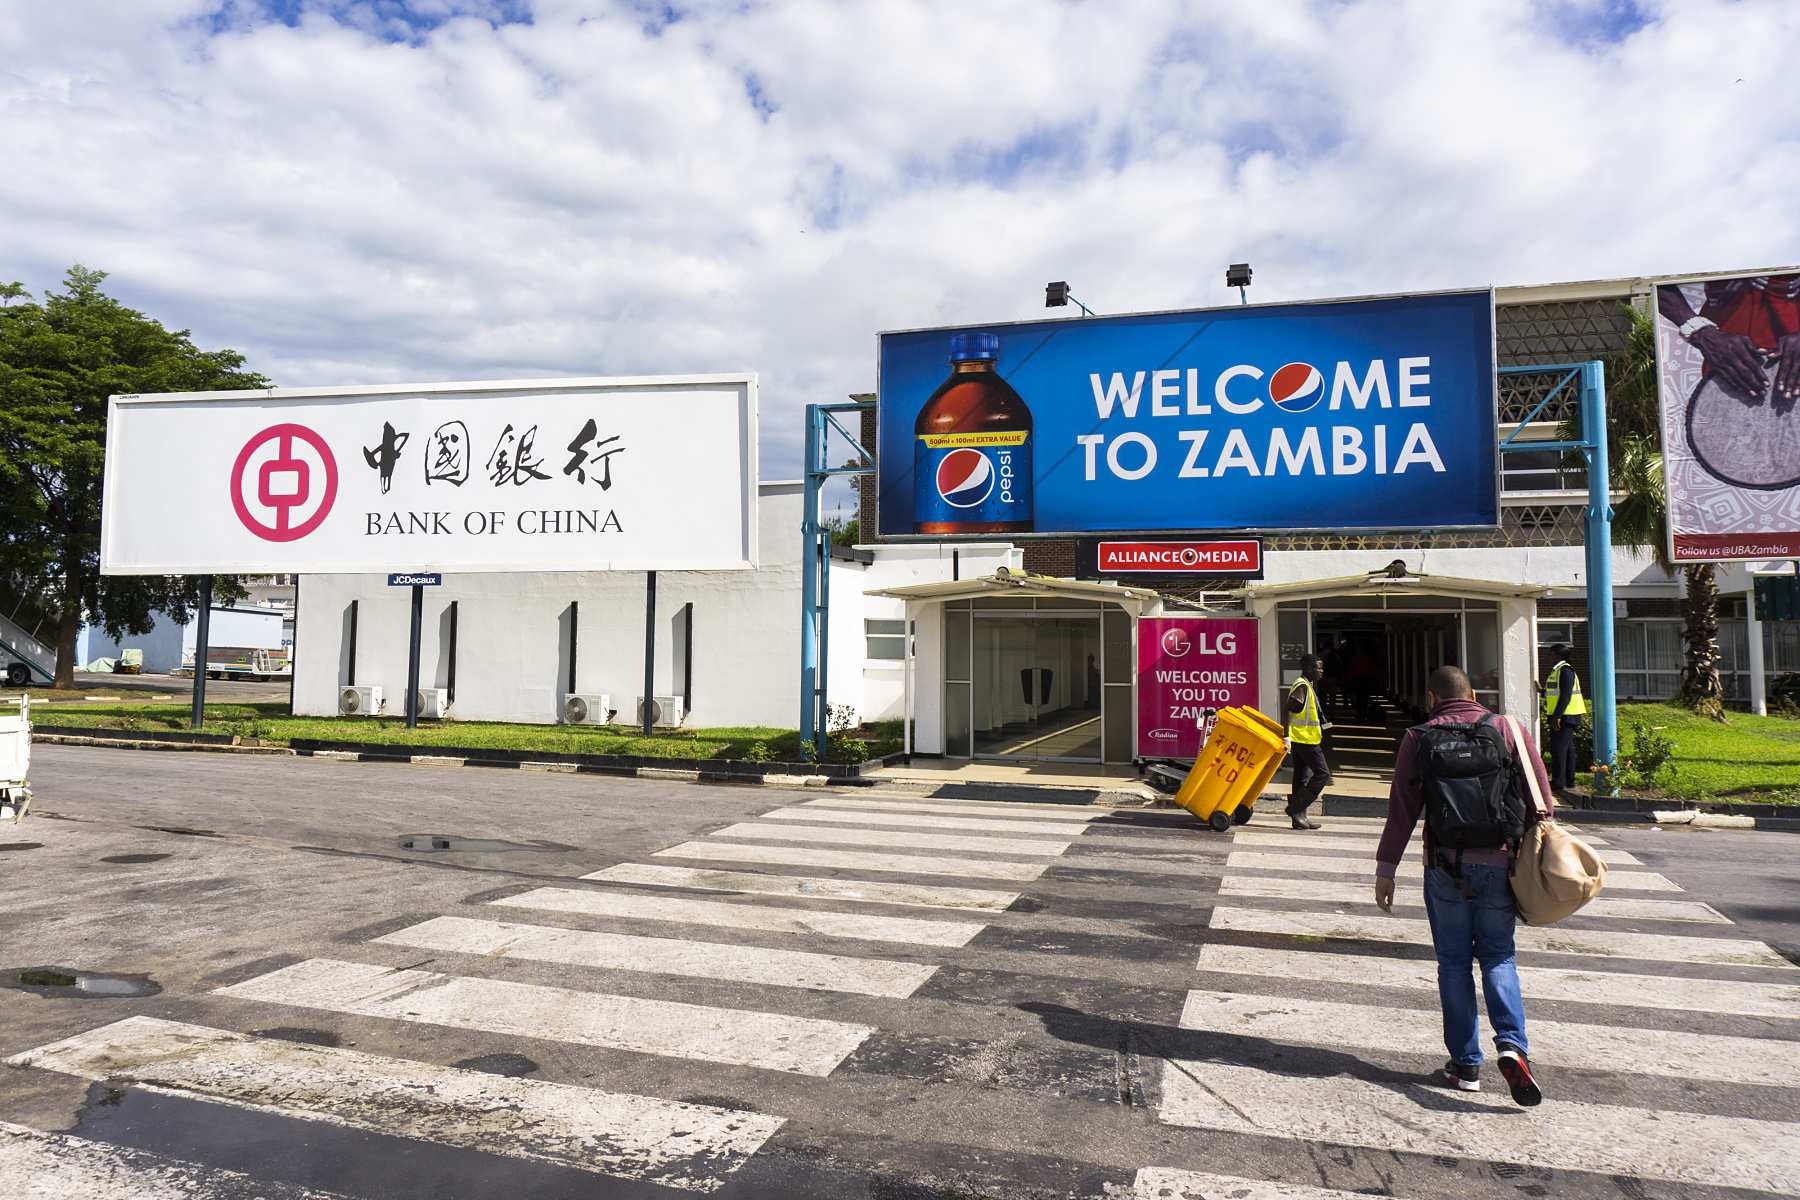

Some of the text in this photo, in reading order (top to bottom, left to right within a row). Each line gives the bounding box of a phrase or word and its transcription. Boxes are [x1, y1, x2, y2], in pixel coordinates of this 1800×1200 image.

[929, 437, 950, 445] 500ml
[363, 418, 626, 495] 中國銀行
[1077, 422, 1446, 480] TO ZAMBIA
[997, 450, 1015, 503] pepsi
[364, 509, 624, 535] BANK OF CHINA
[1107, 551, 1249, 563] ALLIANCE MEDIA
[1676, 544, 1788, 556] Follow us @UBAZambia
[393, 575, 436, 584] JCDecaux
[1200, 632, 1237, 655] LG
[1155, 670, 1247, 684] WELCOMES
[1172, 688, 1230, 702] YOU TO
[1170, 706, 1222, 719] ZAM
